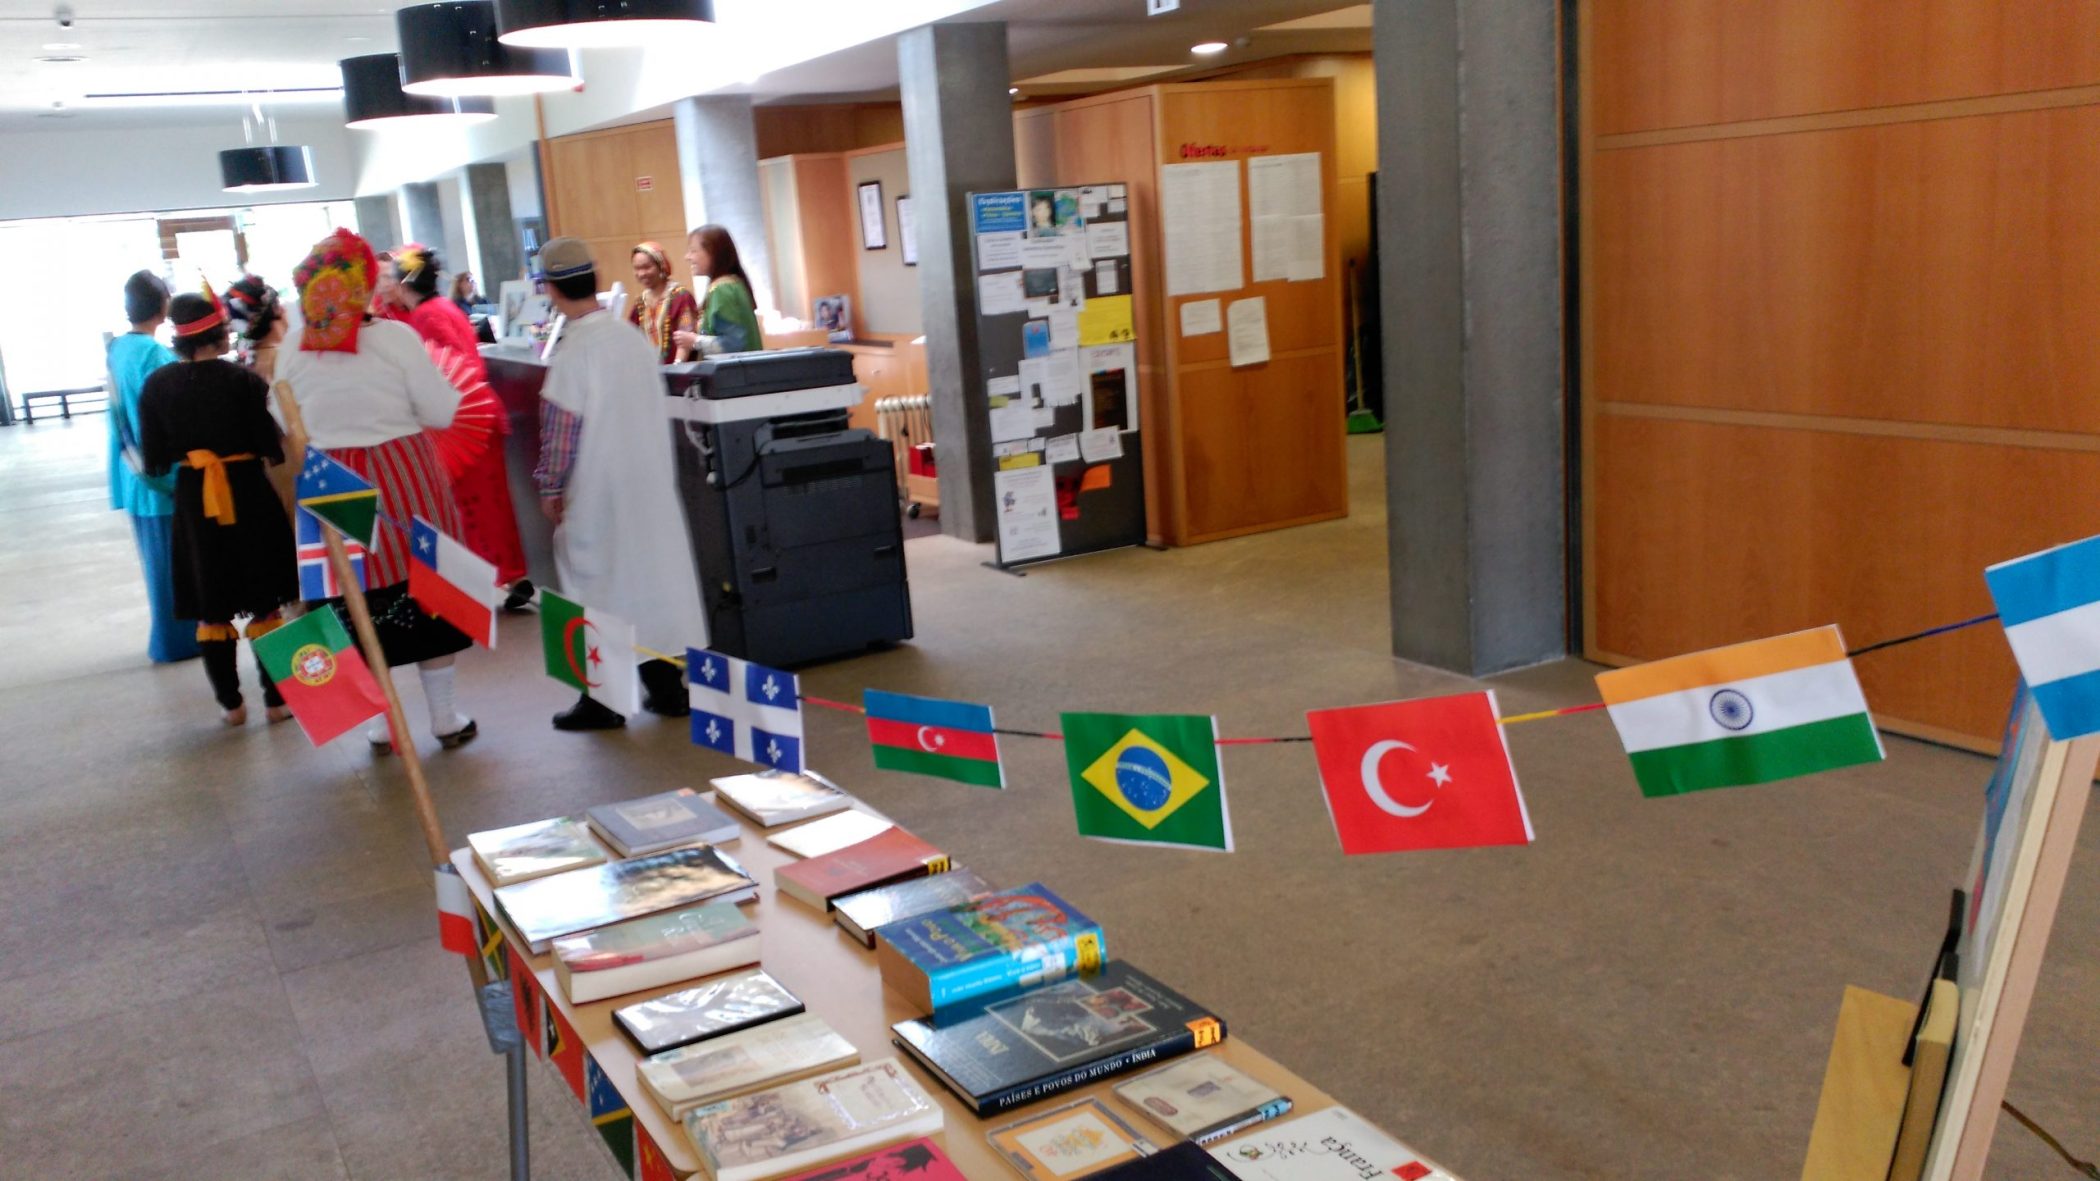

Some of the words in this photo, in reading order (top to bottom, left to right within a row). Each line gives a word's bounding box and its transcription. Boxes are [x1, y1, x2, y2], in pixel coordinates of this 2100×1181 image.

[999, 1089, 1032, 1107] PAÍSES
[1042, 1076, 1073, 1093] POVOS
[1074, 1072, 1088, 1084] DO
[1089, 1060, 1123, 1078] MUNDO
[1320, 1135, 1385, 1181] França
